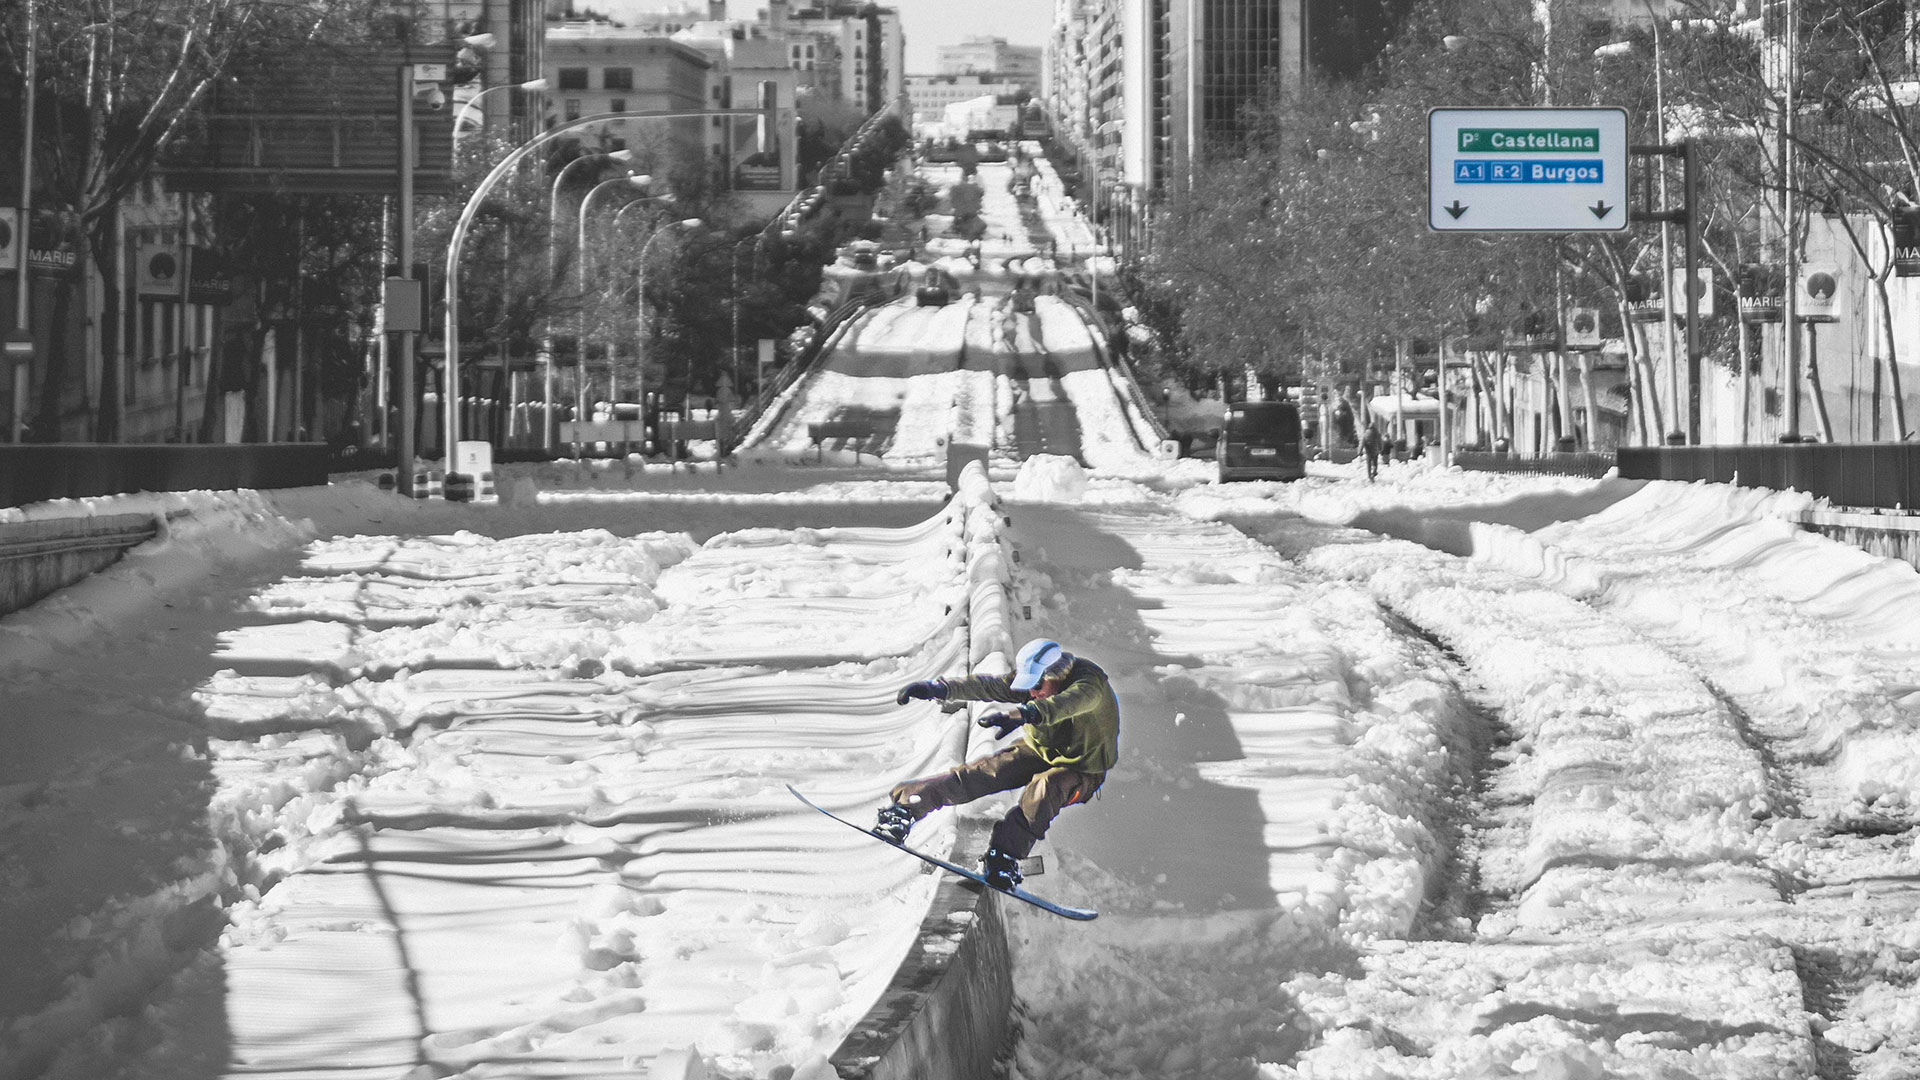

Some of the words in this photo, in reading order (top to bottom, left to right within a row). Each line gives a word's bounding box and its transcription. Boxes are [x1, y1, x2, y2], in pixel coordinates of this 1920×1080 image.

[1491, 132, 1594, 148] Castellana
[1459, 165, 1483, 177] A-1
[1493, 165, 1520, 177] R-2
[1532, 164, 1598, 182] Burgos
[29, 249, 76, 265] MARIE
[191, 278, 230, 291] MARIE
[1628, 298, 1664, 310] MARIE
[1741, 296, 1782, 308] MARIE
